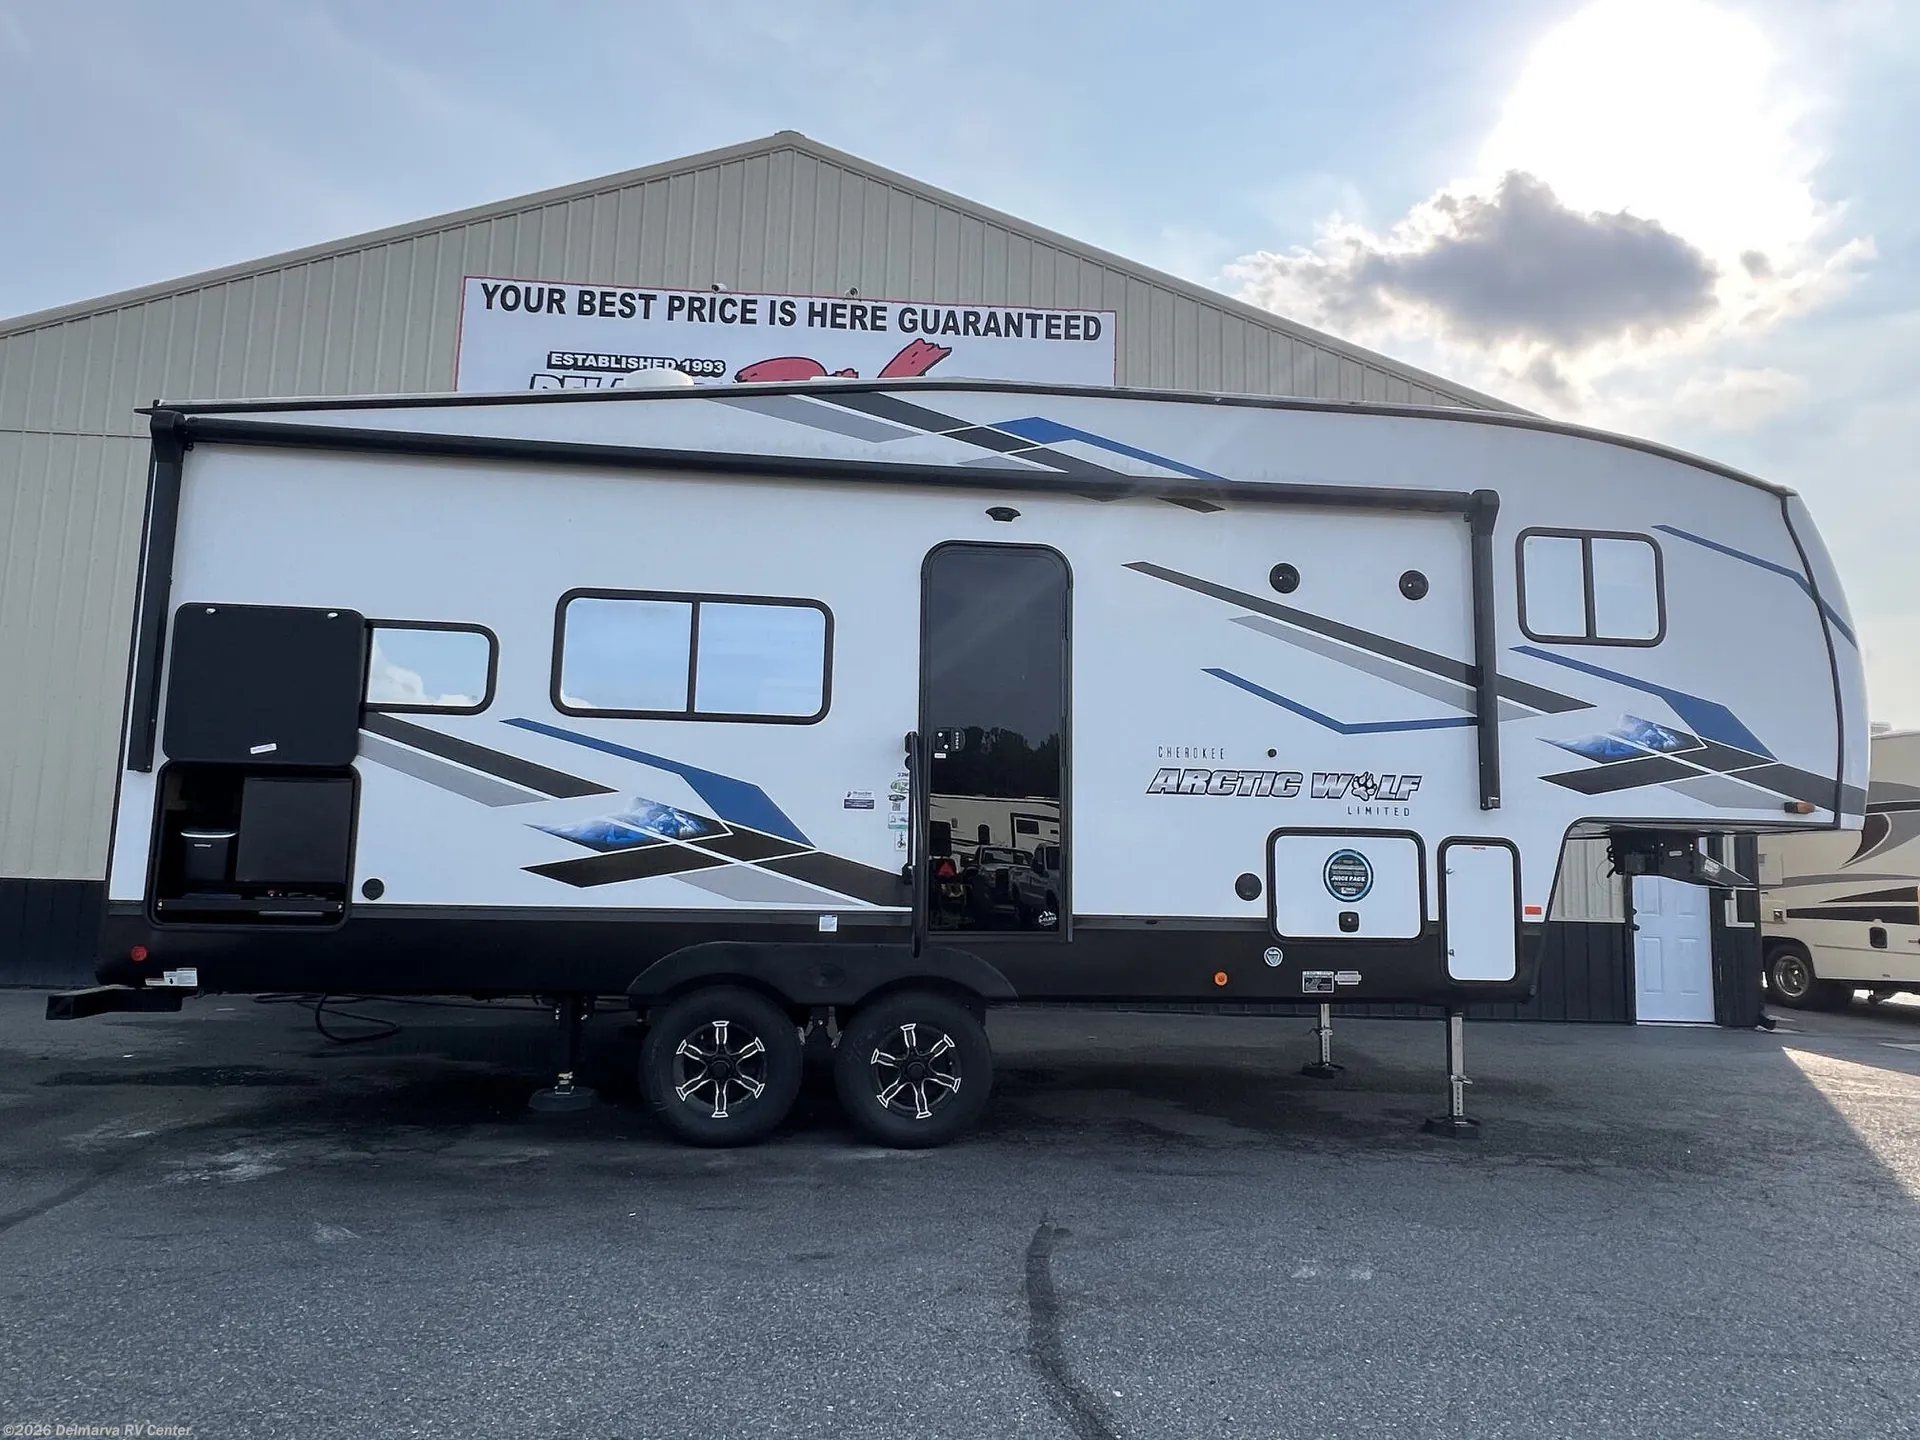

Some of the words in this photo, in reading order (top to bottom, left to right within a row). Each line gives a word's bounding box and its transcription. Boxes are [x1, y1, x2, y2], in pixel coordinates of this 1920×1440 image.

[481, 283, 566, 315] YOUR
[577, 288, 657, 320] BEST
[667, 295, 757, 325] PRICE
[769, 300, 797, 327] IS
[808, 301, 888, 332] HERE
[899, 307, 1101, 342] GUARANTEED
[551, 353, 676, 370] ESTABLISHED
[681, 359, 724, 373] 1993
[1157, 746, 1225, 760] CHEROKEE
[1146, 767, 1304, 797] ARCTIC
[1347, 805, 1410, 817] LIMITED
